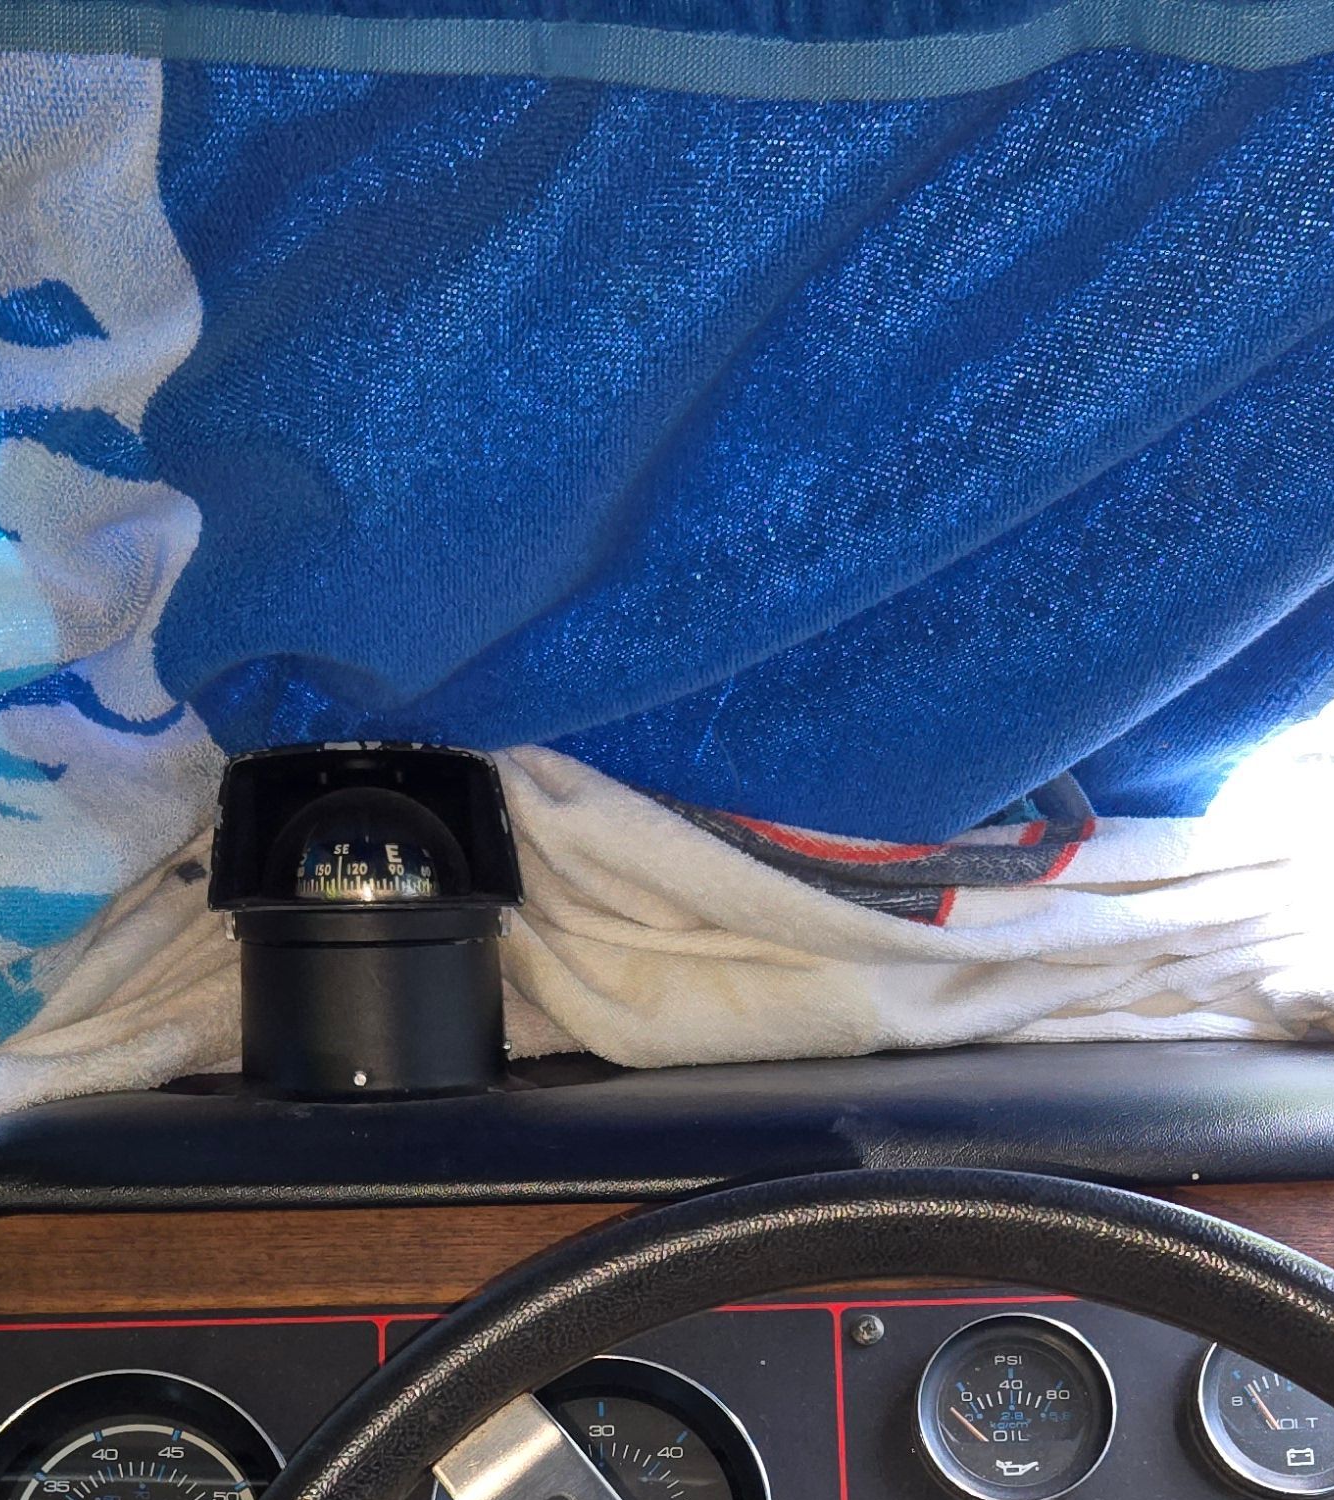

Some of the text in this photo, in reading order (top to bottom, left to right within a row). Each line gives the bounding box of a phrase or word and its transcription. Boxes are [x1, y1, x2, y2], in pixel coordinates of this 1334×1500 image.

[333, 844, 350, 855] SE
[385, 844, 402, 863] E
[315, 864, 332, 876] 150
[347, 863, 368, 875] 120
[389, 864, 405, 875] 90
[994, 1356, 1023, 1366] PSI
[999, 1380, 1023, 1390] 40
[1046, 1390, 1070, 1400] 80
[589, 1425, 615, 1437] 30
[993, 1430, 1030, 1442] OIL
[91, 1448, 118, 1461] 40
[158, 1446, 184, 1459] 45
[657, 1446, 683, 1459] 40
[43, 1480, 70, 1493] 35
